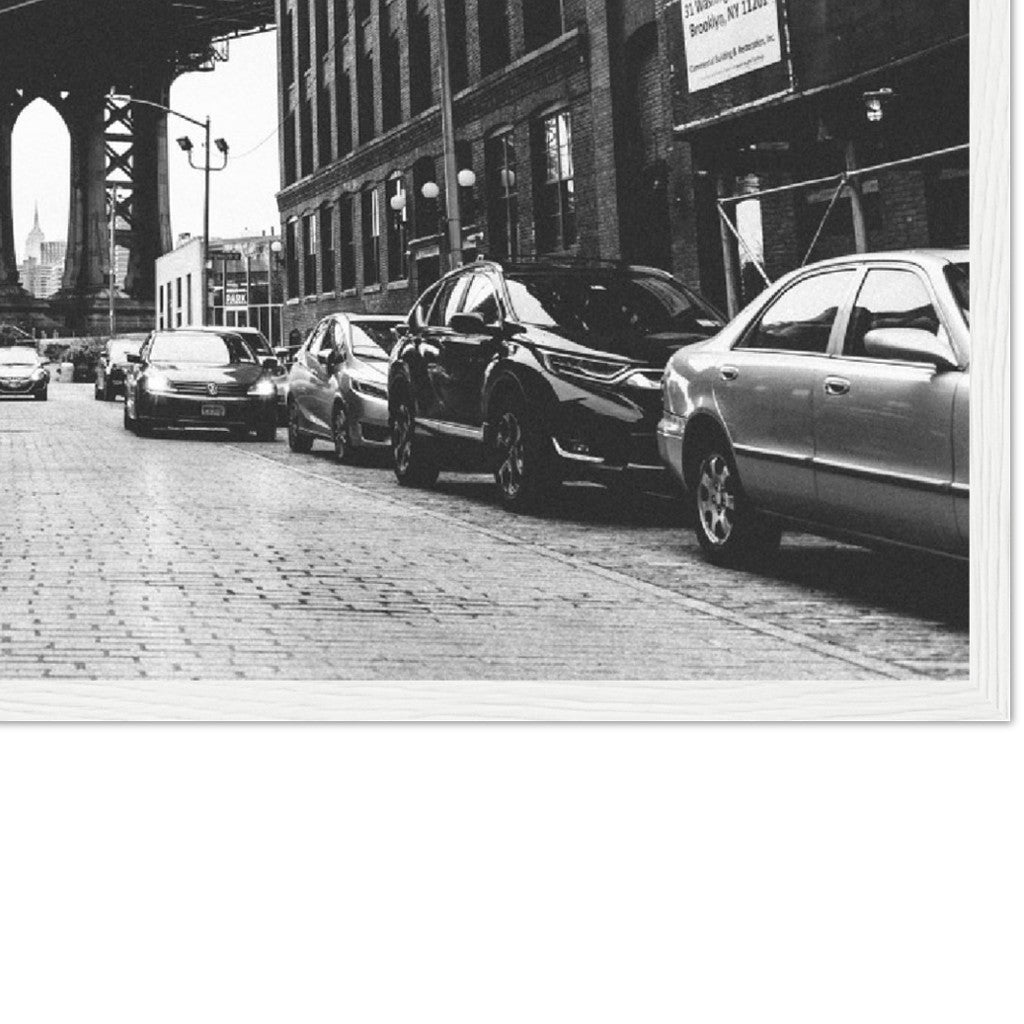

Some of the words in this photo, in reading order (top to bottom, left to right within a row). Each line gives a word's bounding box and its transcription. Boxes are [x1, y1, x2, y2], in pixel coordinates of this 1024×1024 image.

[684, 2, 694, 18] 31
[689, 14, 727, 37] Brooklyn,
[727, 3, 739, 22] NY
[226, 293, 247, 304] PARK
